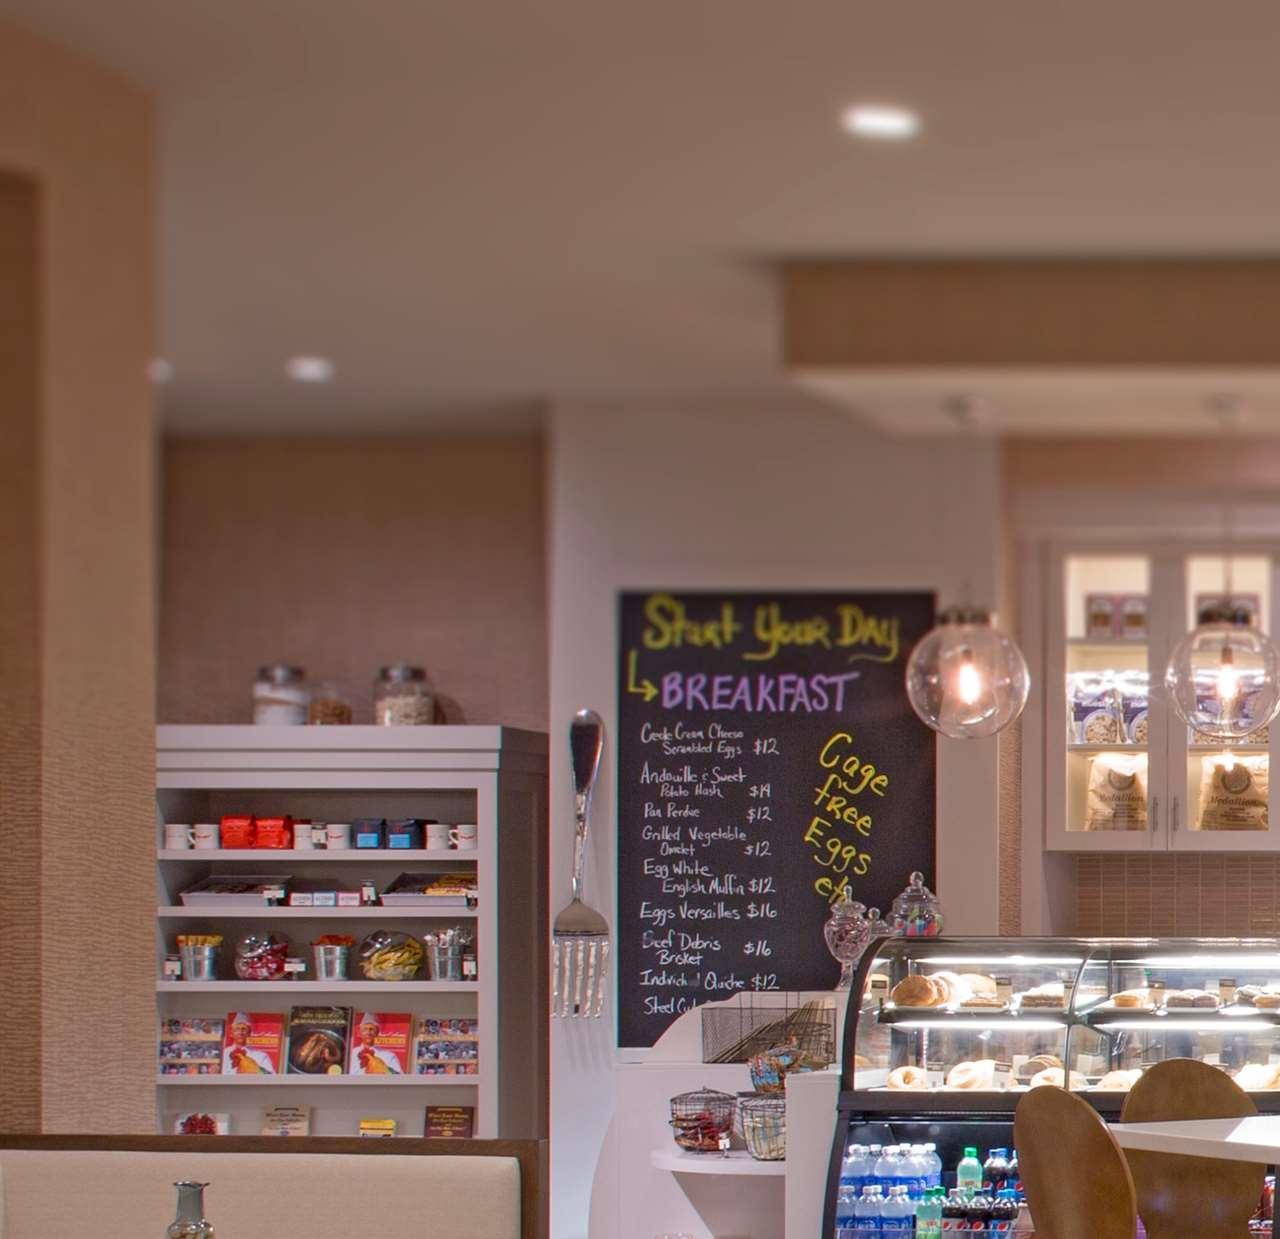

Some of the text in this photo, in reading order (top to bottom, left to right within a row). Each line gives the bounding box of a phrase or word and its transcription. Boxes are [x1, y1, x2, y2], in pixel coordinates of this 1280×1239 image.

[642, 592, 742, 650] Start
[661, 672, 860, 712] BREAKFAST
[709, 723, 744, 740] Cheese
[717, 741, 742, 759] Eggs
[753, 738, 779, 755] $12
[711, 766, 747, 784] Sweet
[820, 733, 889, 797] Cage
[660, 783, 690, 797] Potato
[746, 806, 772, 824] $12
[642, 825, 747, 847] Grilled Vegetable
[804, 817, 871, 874] Eggs
[744, 840, 772, 857] $12
[644, 858, 713, 878] Egg White
[662, 874, 776, 897] English Muffin $12
[640, 901, 777, 926] Eggs Versailles $16
[642, 929, 772, 956] Beef Debris $16
[656, 949, 703, 965] Brisket
[751, 973, 780, 991] $12
[644, 996, 674, 1015] Steel
